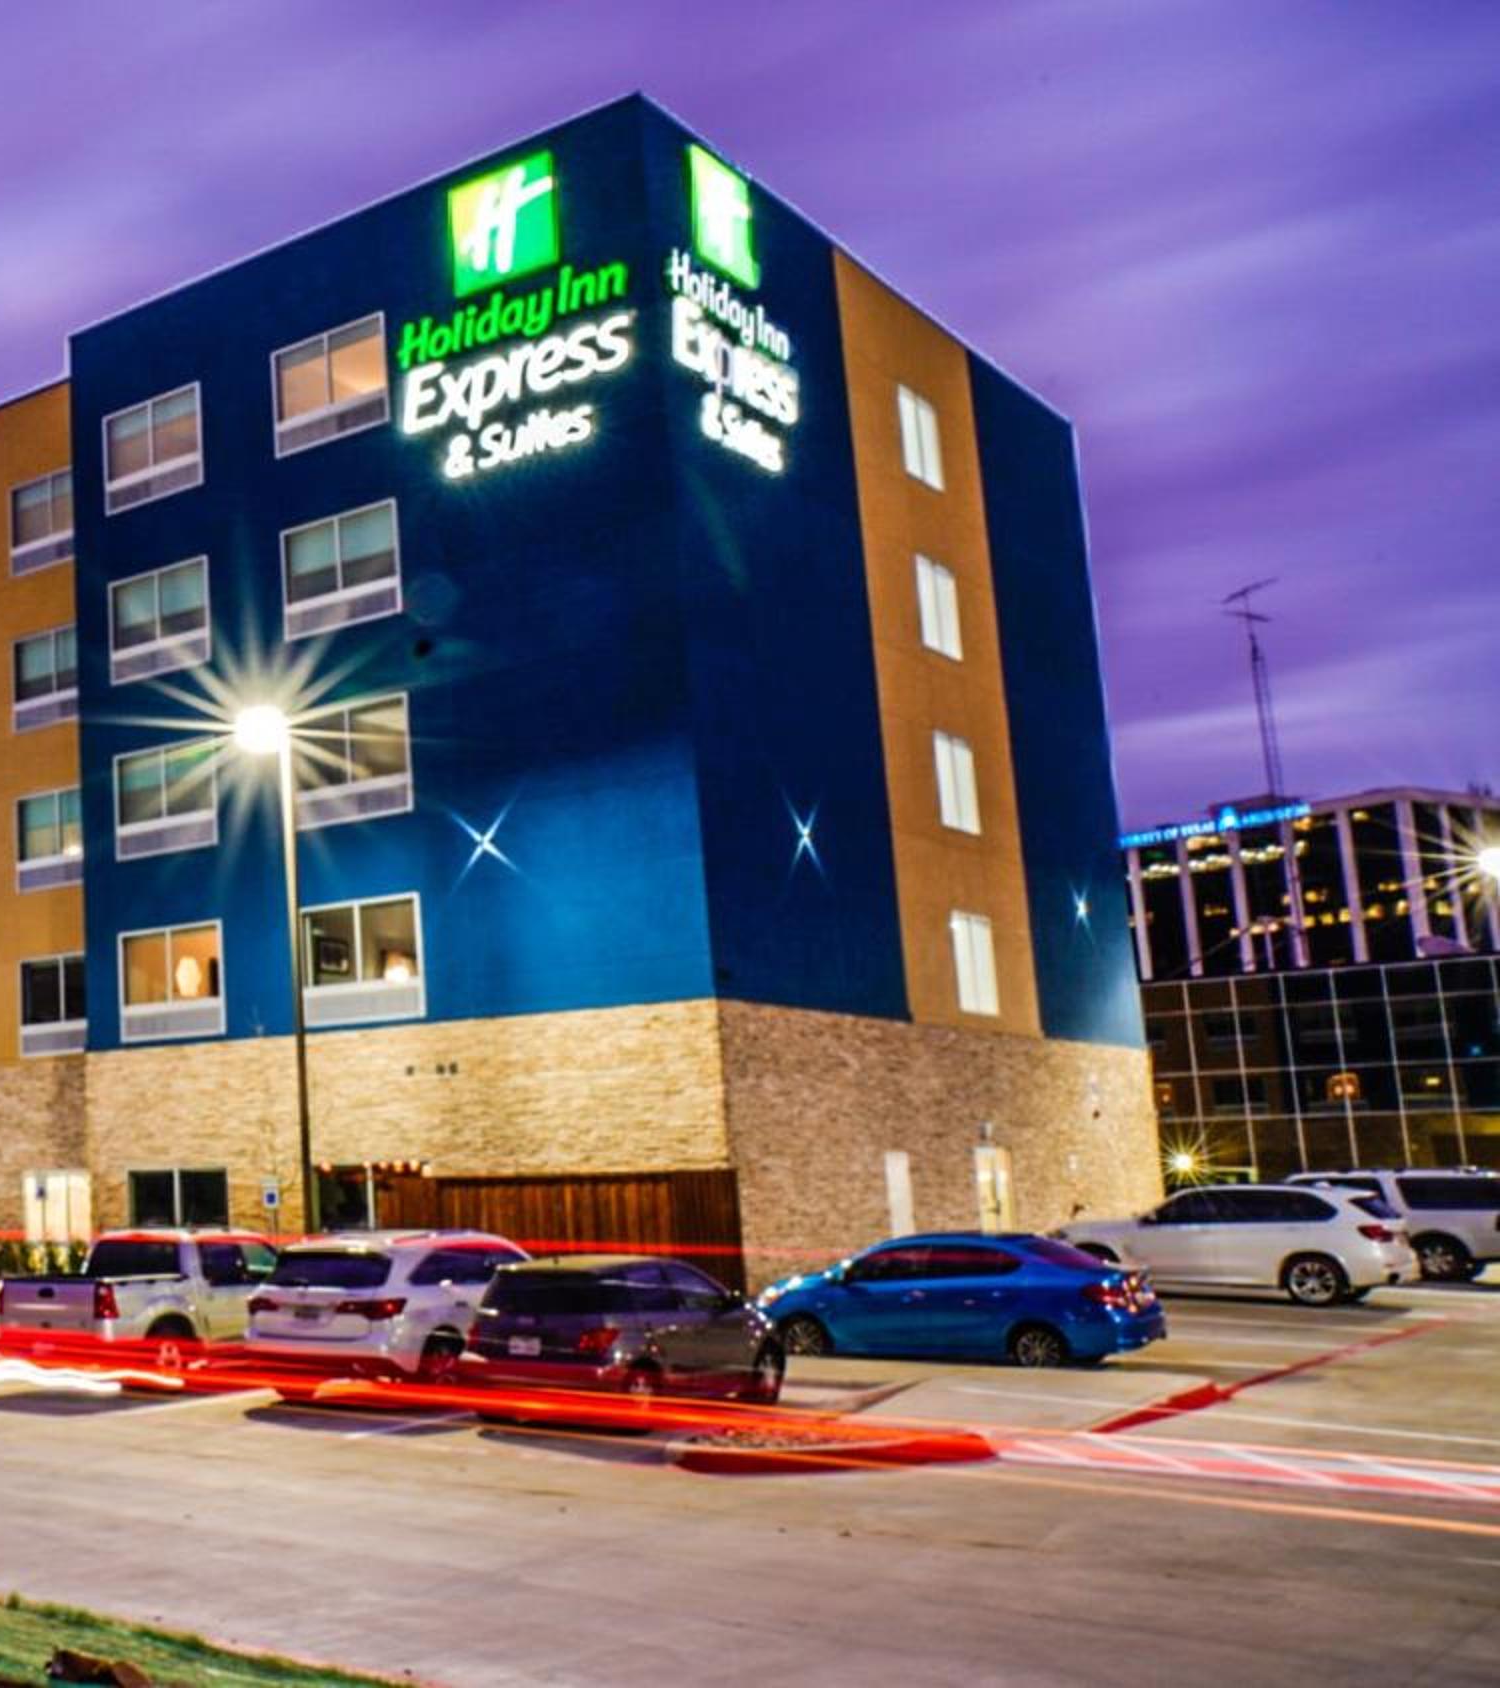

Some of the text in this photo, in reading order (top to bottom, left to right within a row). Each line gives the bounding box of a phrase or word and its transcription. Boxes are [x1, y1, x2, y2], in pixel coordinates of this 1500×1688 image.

[399, 264, 627, 370] Holiday Inn
[668, 248, 790, 362] Holiday Inn
[402, 315, 631, 435] Express
[445, 405, 592, 478] & Suites
